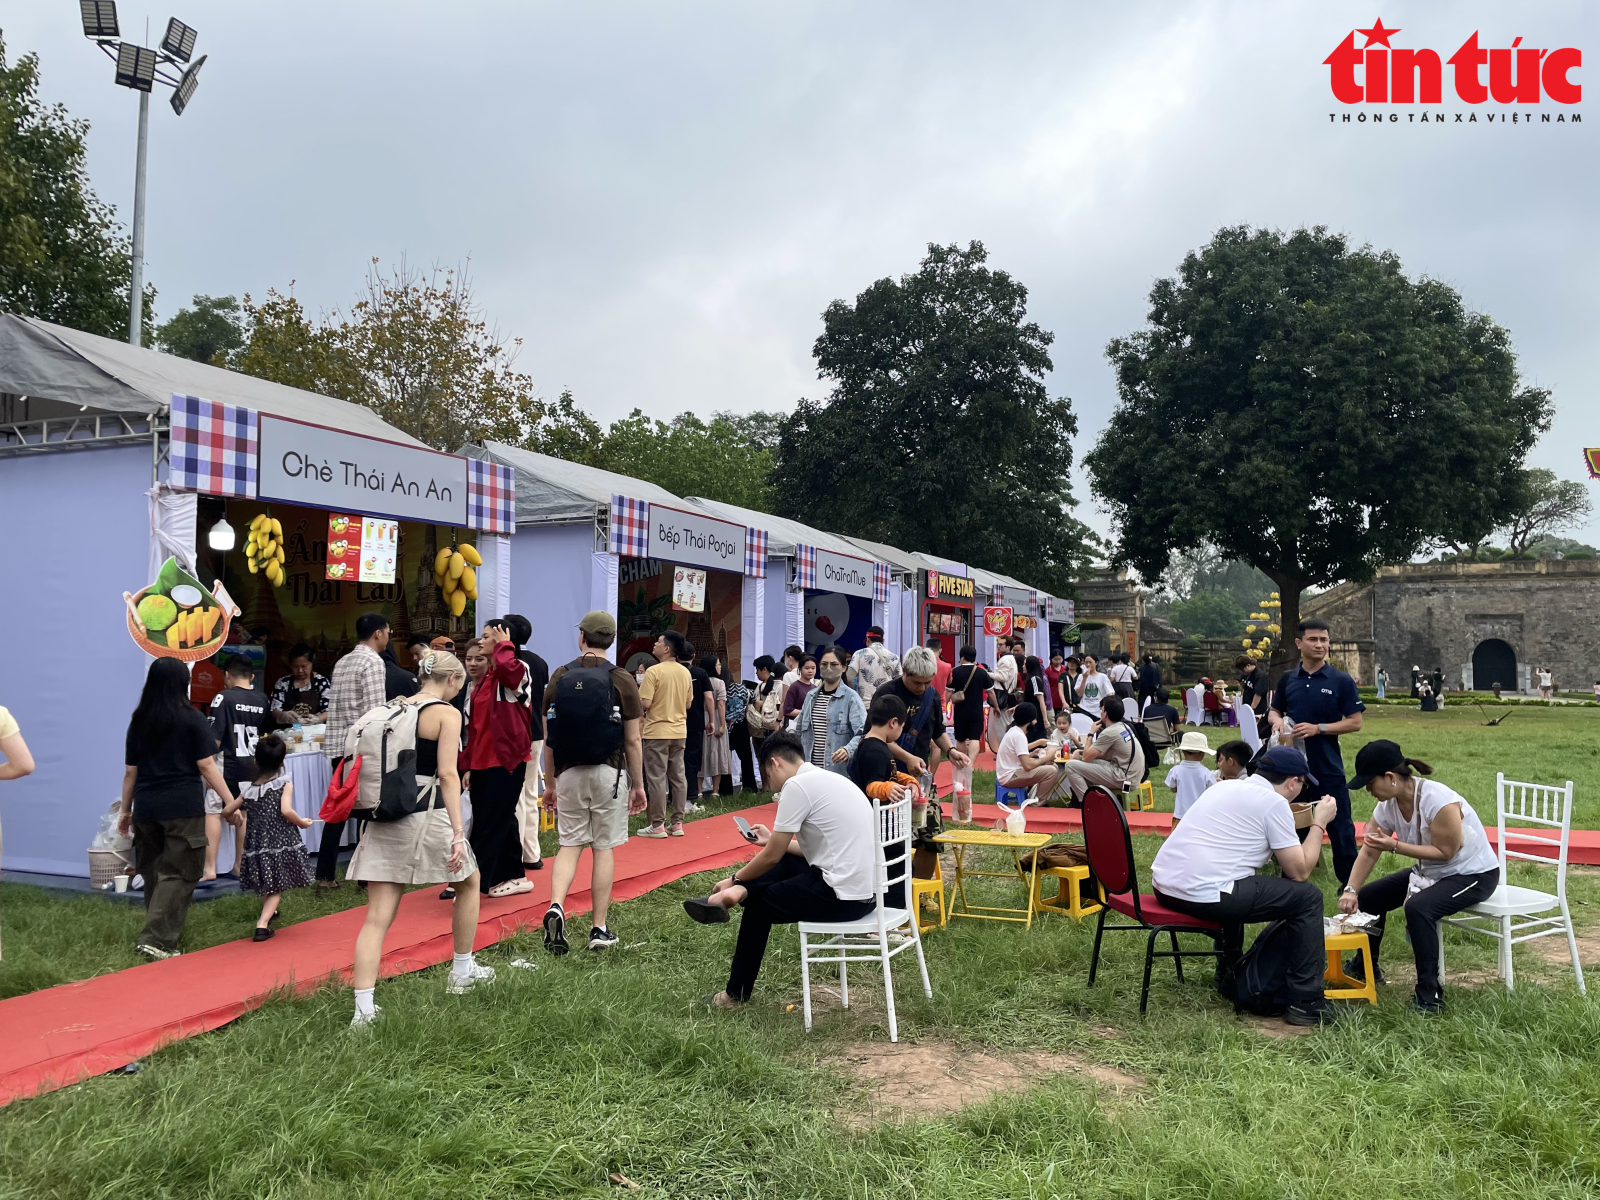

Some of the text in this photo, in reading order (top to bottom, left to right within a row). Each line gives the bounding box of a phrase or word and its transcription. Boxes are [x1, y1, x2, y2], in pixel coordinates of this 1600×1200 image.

[282, 451, 452, 503] Chè Thái An An
[659, 524, 736, 559] Bếp Thái Porjai
[824, 563, 866, 587] ChaTraMue
[939, 575, 974, 598] FIVE STAR
